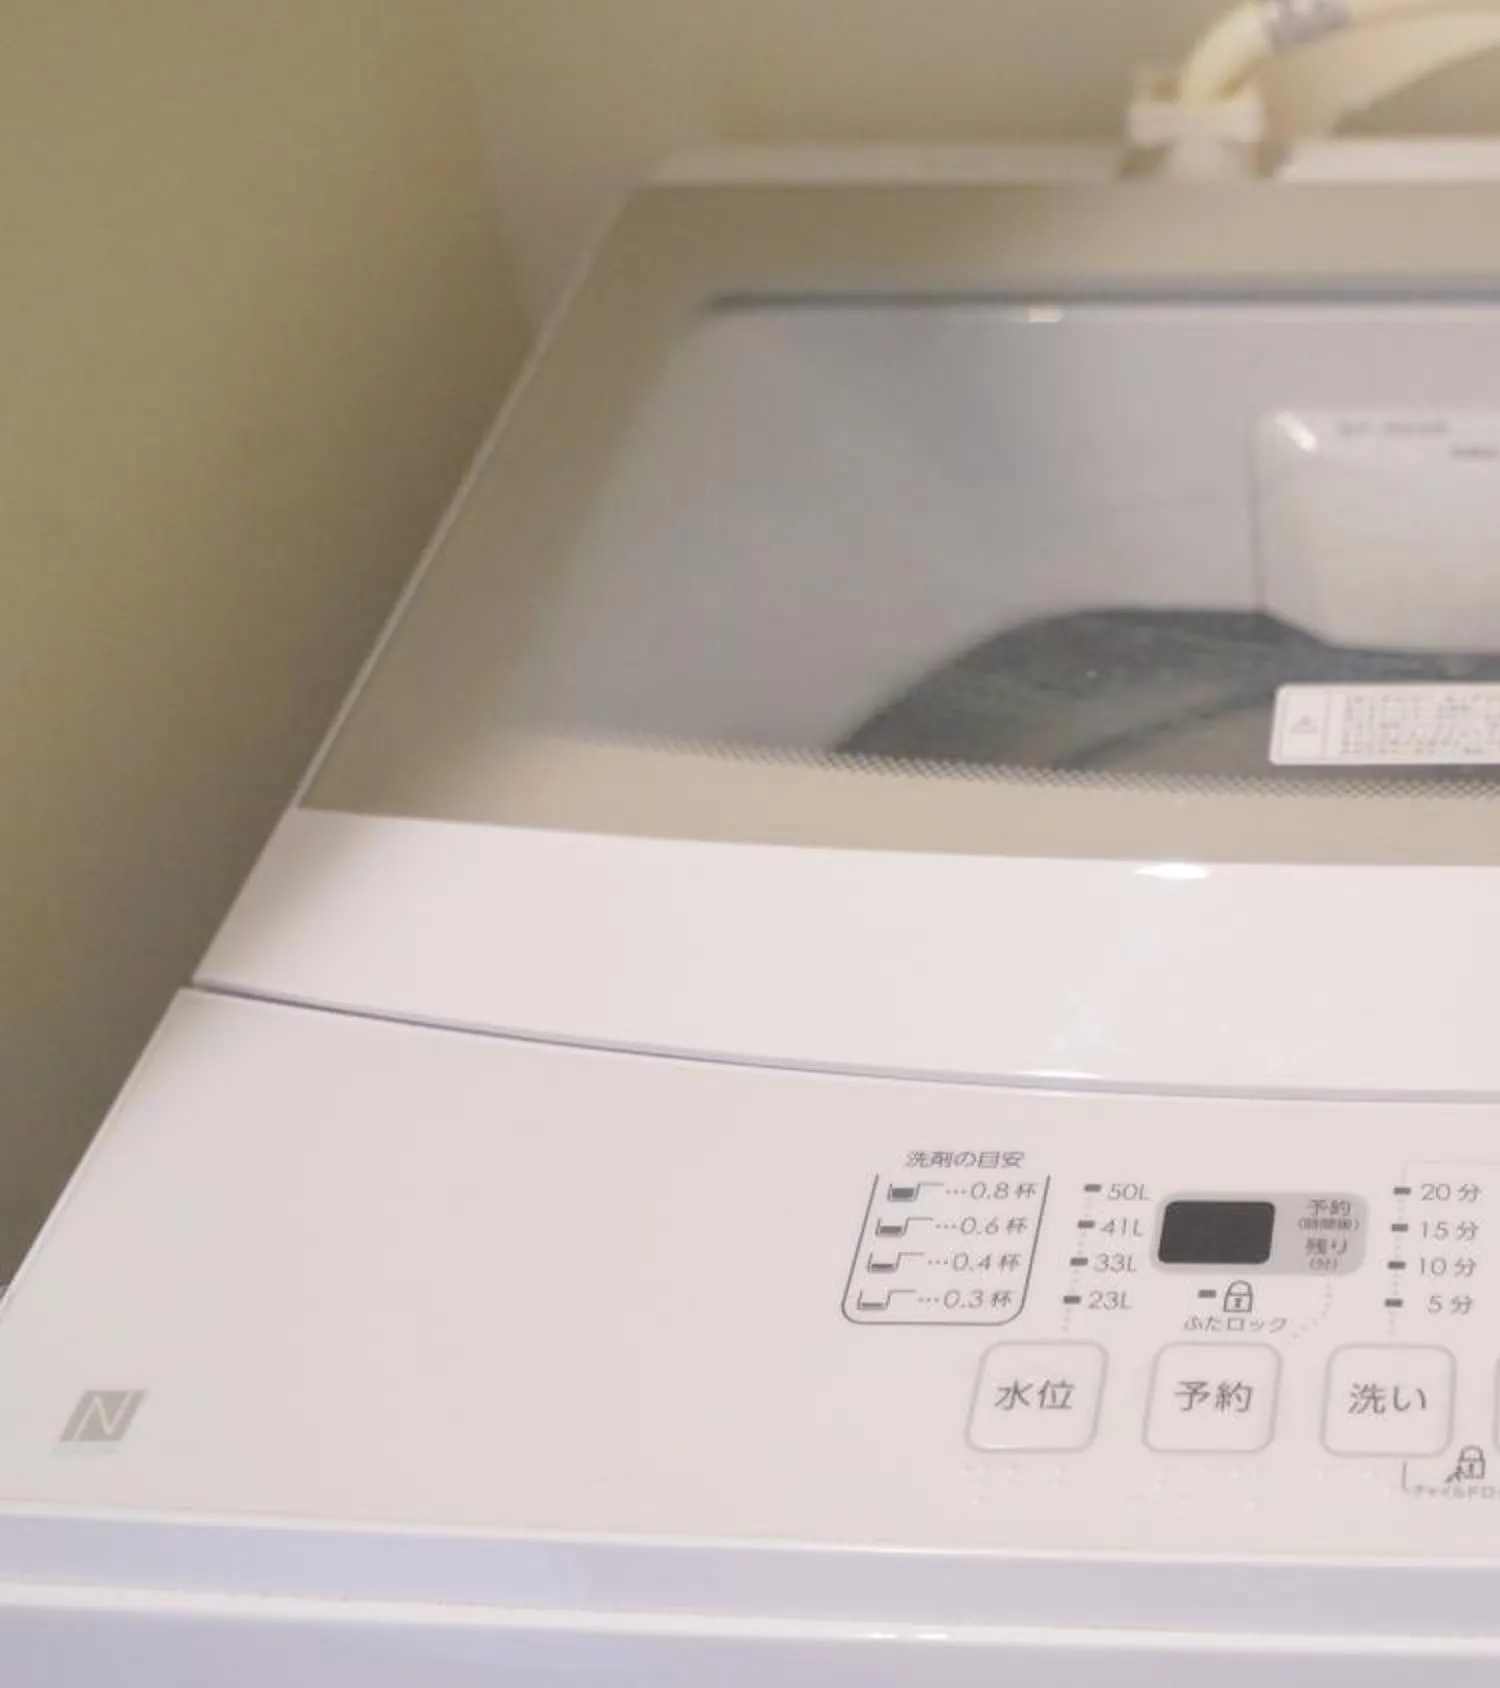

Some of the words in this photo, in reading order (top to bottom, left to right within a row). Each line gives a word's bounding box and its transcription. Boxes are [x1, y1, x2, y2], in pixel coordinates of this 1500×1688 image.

[905, 1151, 1025, 1169] 洗剤の目安
[1108, 1184, 1150, 1201] 50L
[1100, 1217, 1143, 1237] 41L
[1093, 1252, 1136, 1274] 33L
[1088, 1290, 1132, 1311] 23L
[1183, 1315, 1287, 1332] ふたロック
[994, 1380, 1075, 1411] 水位
[1175, 1381, 1253, 1413] 予約
[1348, 1383, 1427, 1414] 洗い
